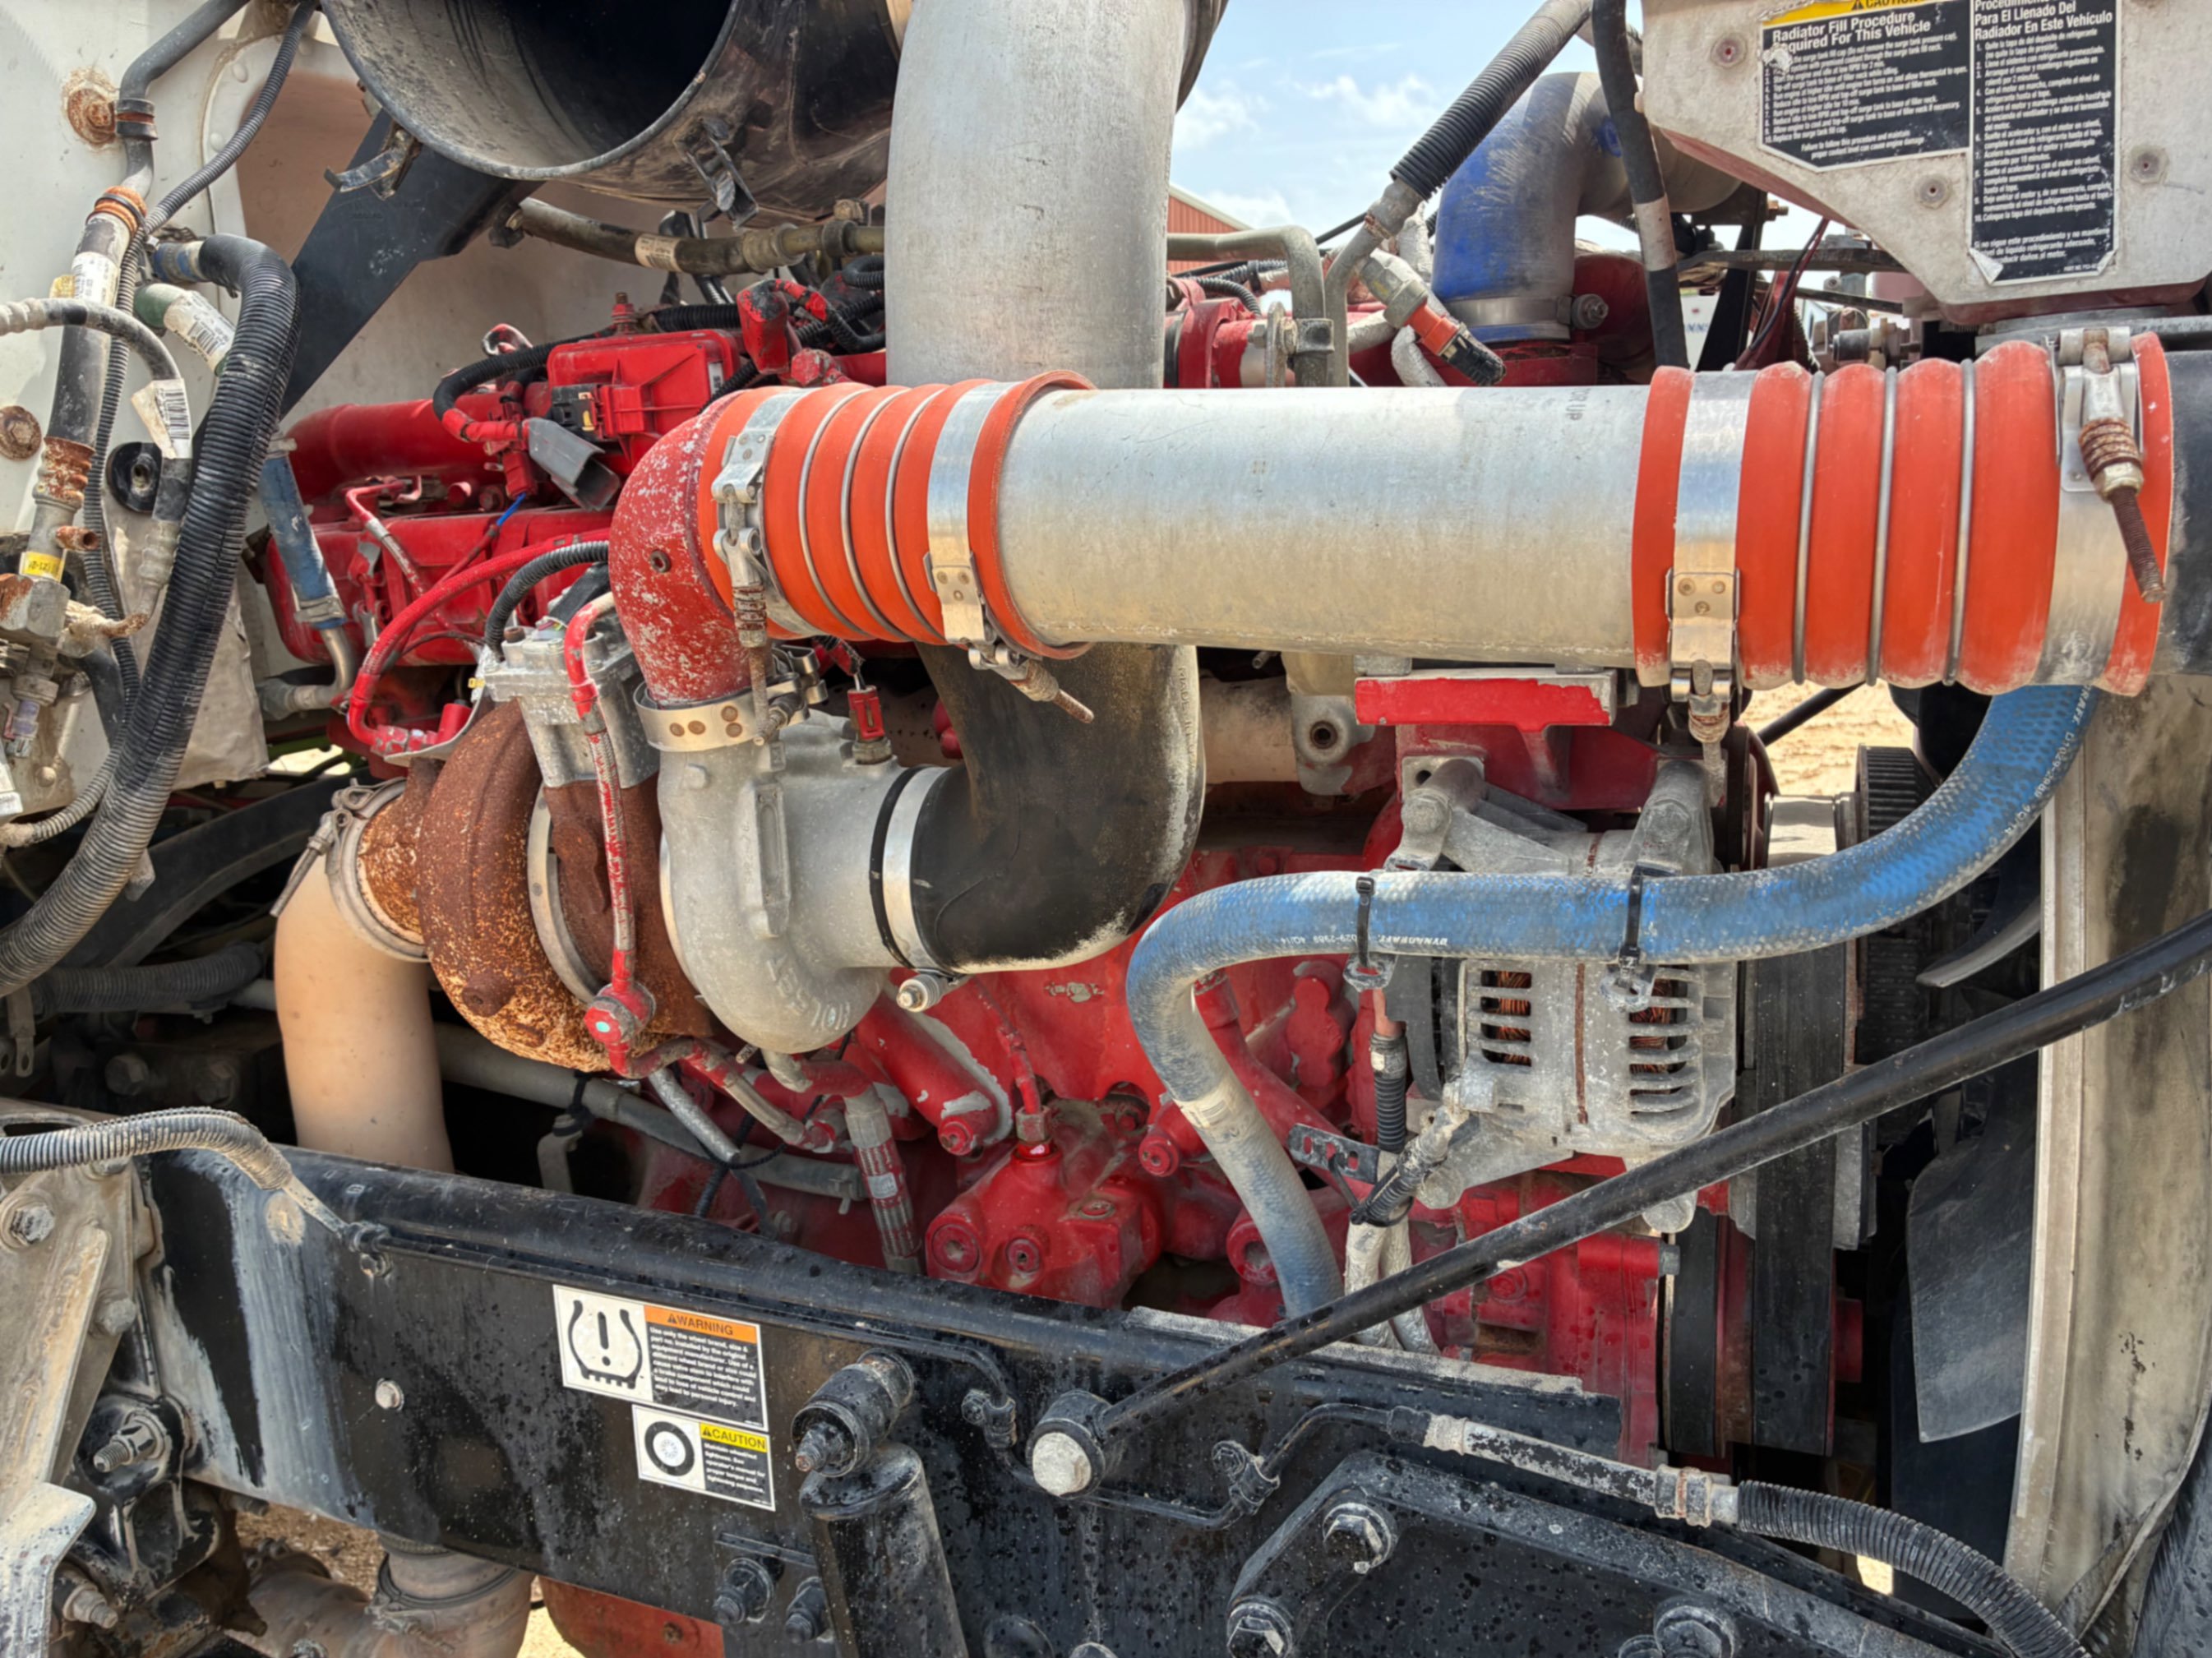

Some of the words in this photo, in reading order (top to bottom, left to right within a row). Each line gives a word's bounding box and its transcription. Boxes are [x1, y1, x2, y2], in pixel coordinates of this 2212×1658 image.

[1772, 25, 1826, 42] Radiator
[1828, 18, 1848, 34] Fill
[1850, 12, 1915, 30] Procedure
[1974, 13, 1998, 26] Para
[2001, 9, 2011, 22] El
[2014, 5, 2056, 21] Llenado
[2058, 1, 2076, 15] Del
[1974, 23, 2022, 40] Radiador
[2025, 21, 2039, 34] En
[2040, 17, 2064, 31] Este
[2066, 10, 2113, 28] Vehículo
[1784, 35, 1828, 53] quired
[1831, 33, 1852, 46] For
[1854, 27, 1882, 42] This
[1884, 20, 1932, 39] Vehicle
[677, 1315, 733, 1336] WARNING
[713, 1428, 766, 1449] CAUTION
